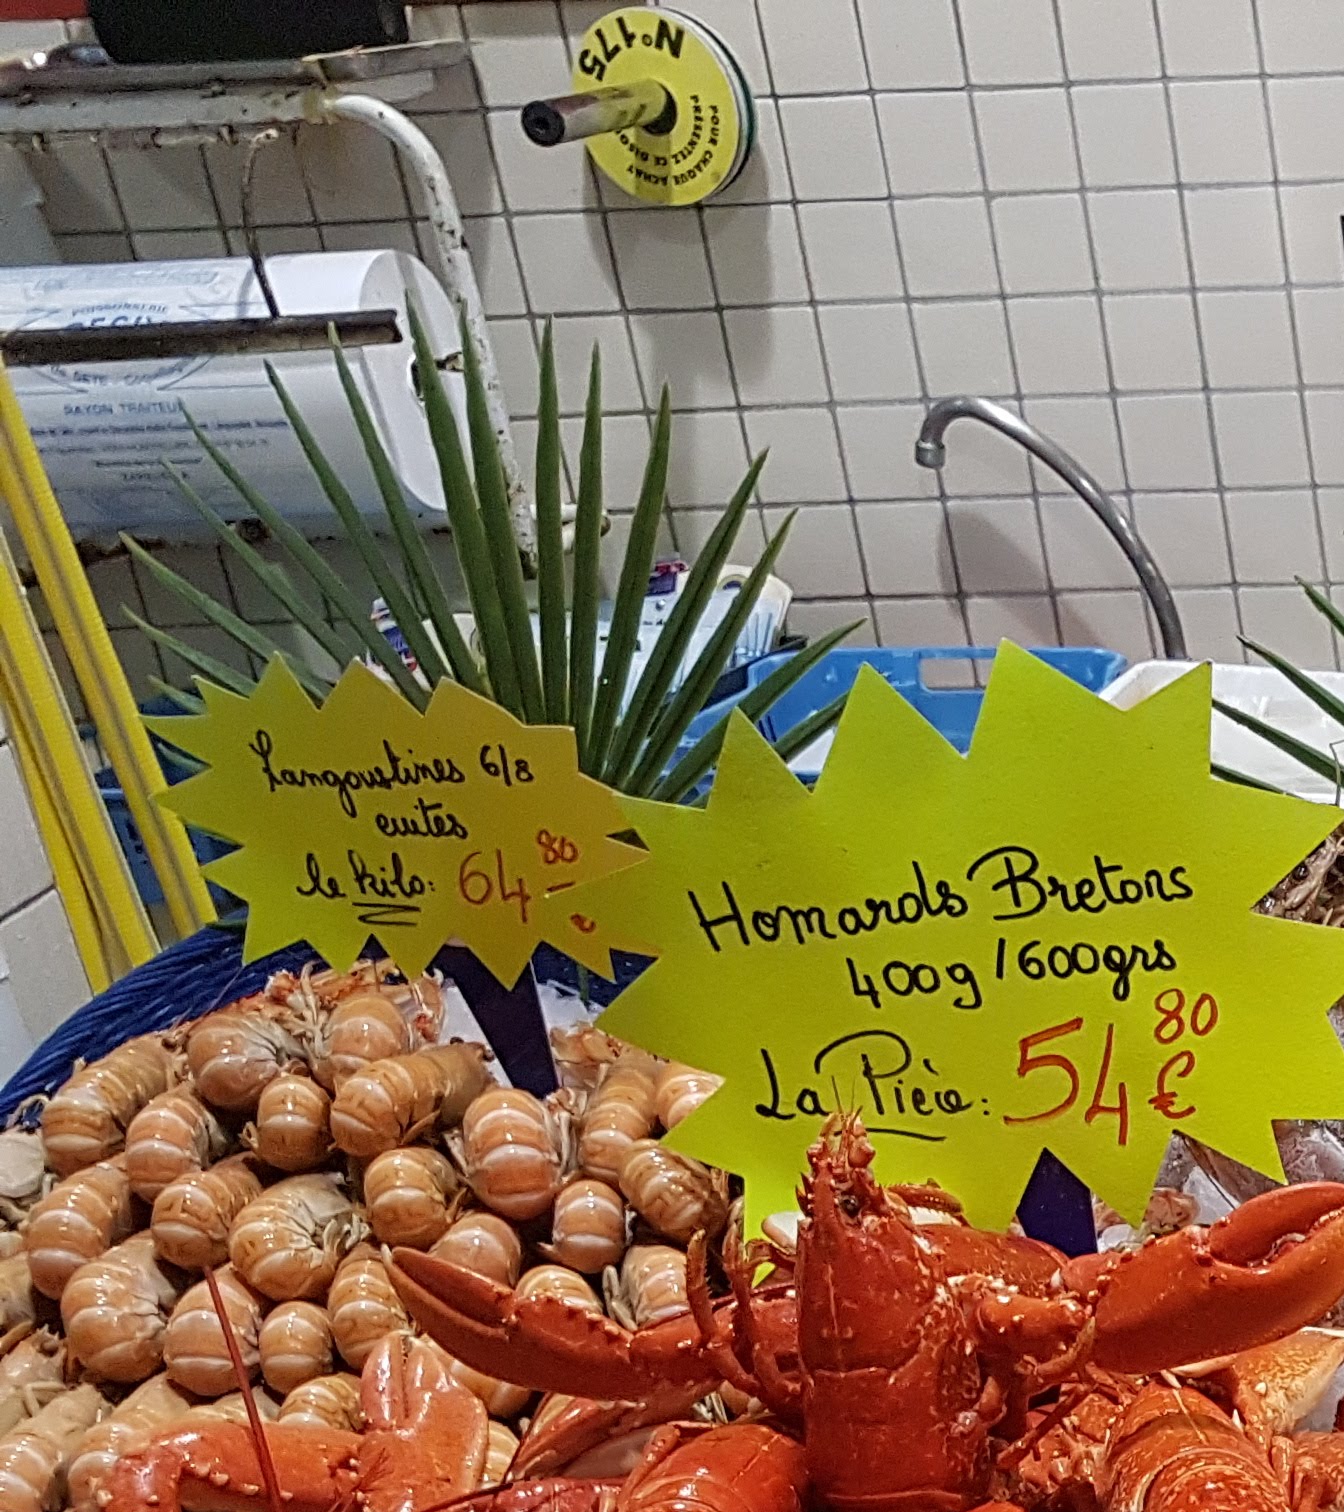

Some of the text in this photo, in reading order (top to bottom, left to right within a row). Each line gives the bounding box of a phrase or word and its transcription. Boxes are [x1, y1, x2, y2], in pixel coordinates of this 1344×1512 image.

[248, 730, 535, 818] Langoustines 6/8
[296, 853, 347, 899] le
[687, 845, 1194, 952] Homards Bretons
[755, 1048, 832, 1120] La
[1003, 1017, 1129, 1147] 54
